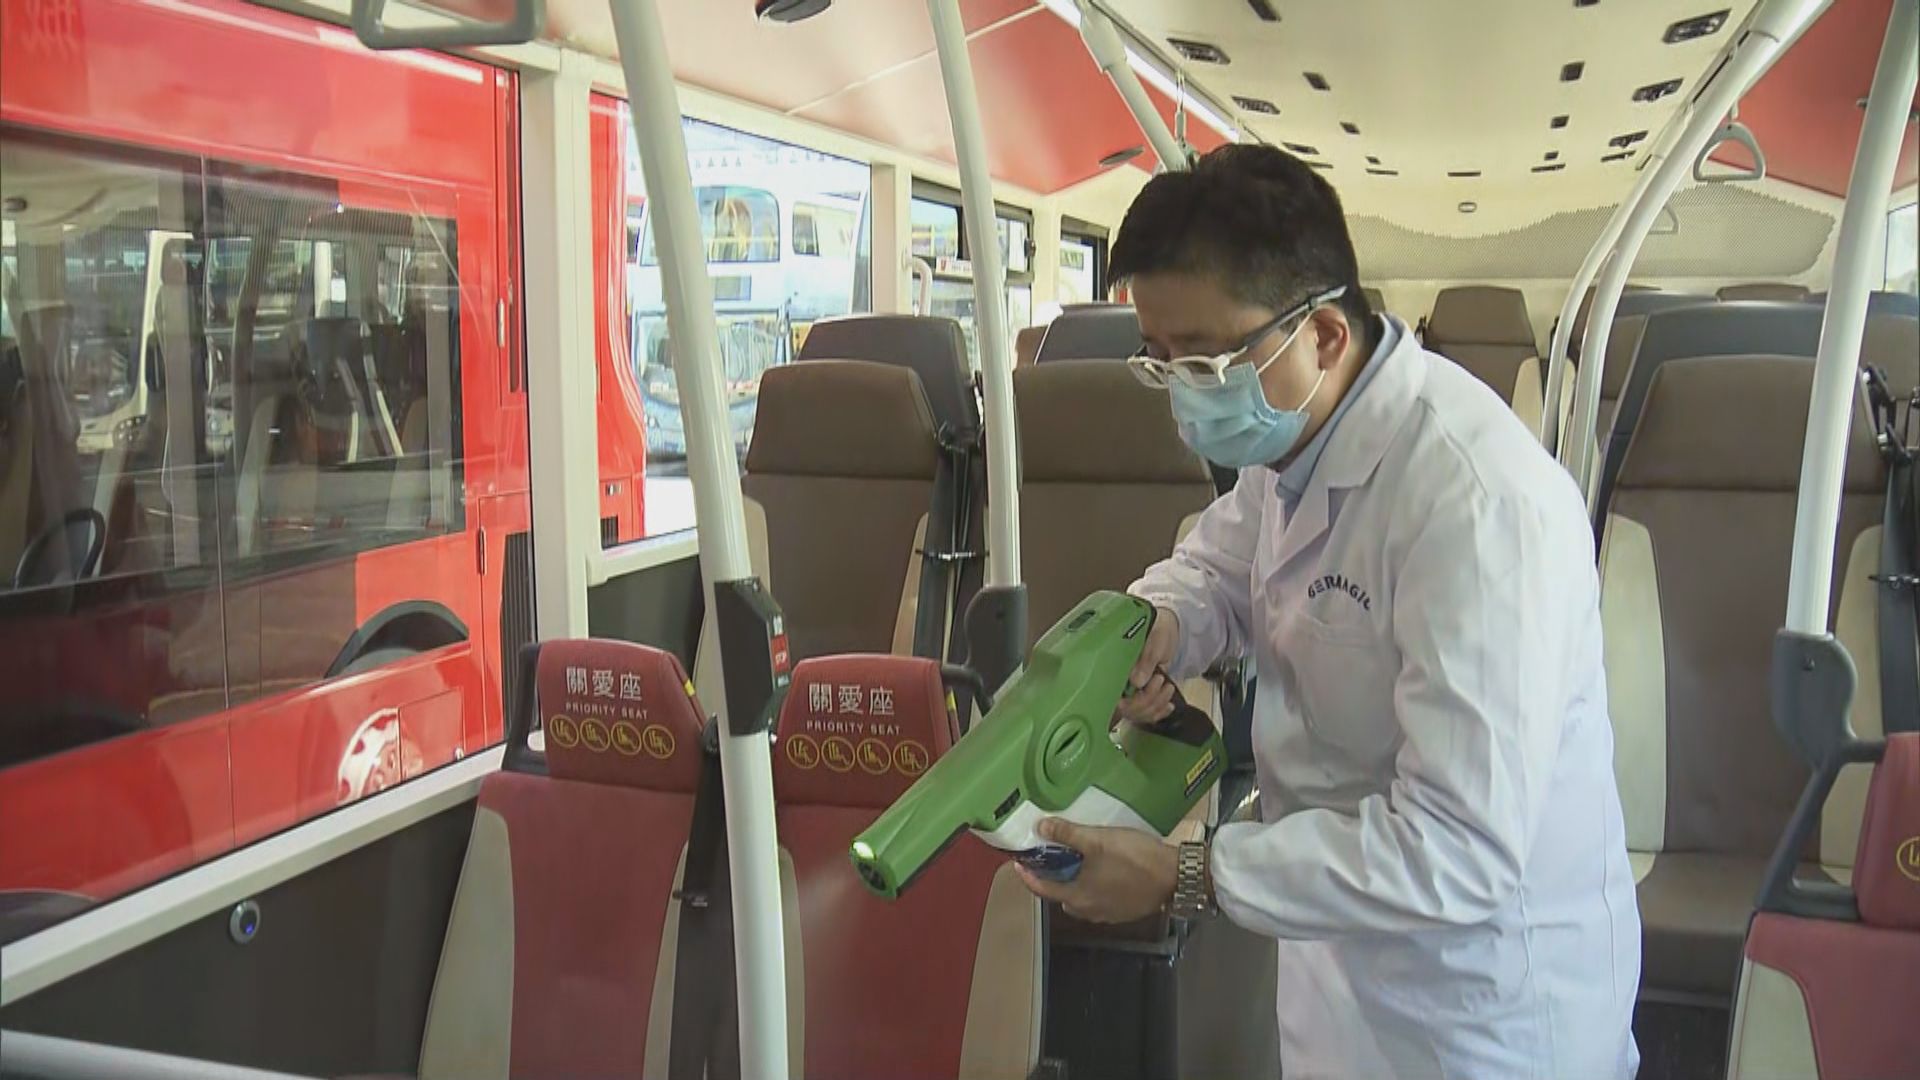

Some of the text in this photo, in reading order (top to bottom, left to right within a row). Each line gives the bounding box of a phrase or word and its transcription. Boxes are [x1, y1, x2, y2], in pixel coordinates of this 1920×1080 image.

[566, 665, 642, 701] 關愛座
[565, 701, 648, 720] PRIORITY SEAT
[808, 682, 895, 716] 關愛座
[806, 719, 901, 736] PRIORITY SEAT
